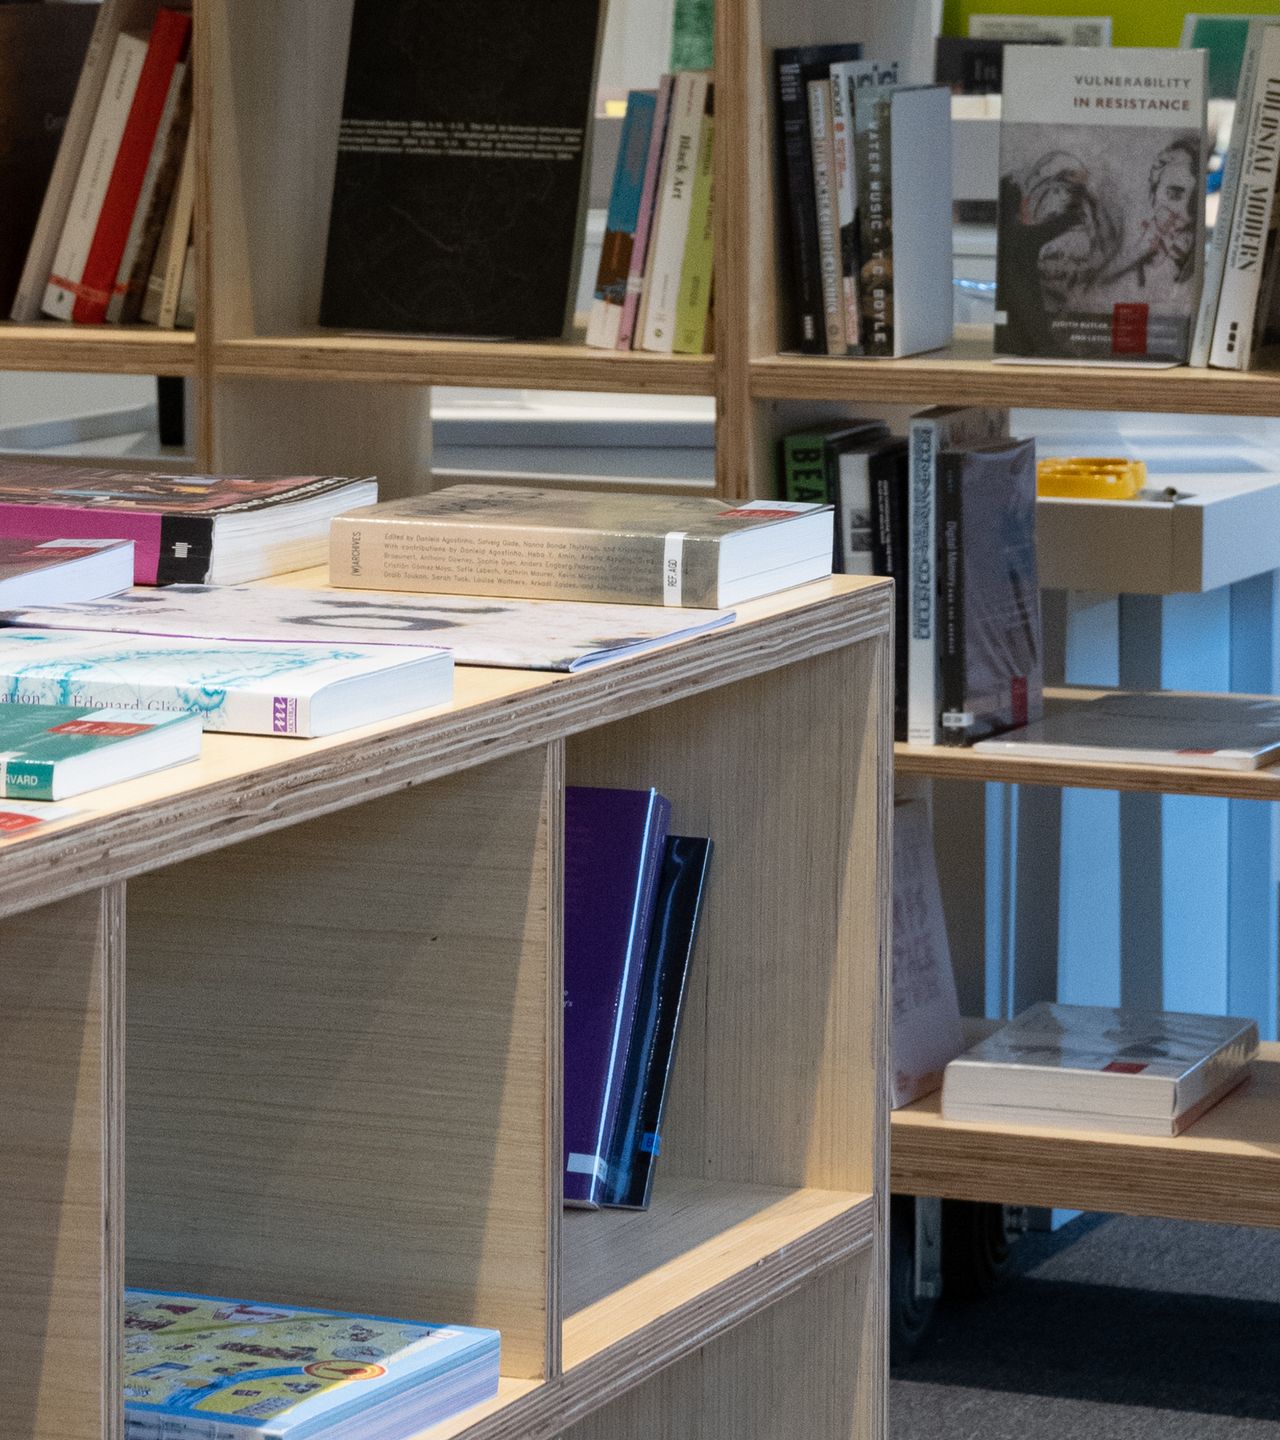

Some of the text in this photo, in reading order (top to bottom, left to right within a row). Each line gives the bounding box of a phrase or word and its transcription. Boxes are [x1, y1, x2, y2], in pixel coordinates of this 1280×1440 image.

[1073, 74, 1191, 89] VULNERABILITY
[1073, 96, 1190, 111] IN RESISTANCE
[1236, 184, 1269, 274] MODERN
[349, 530, 363, 577] (W)ARCHIVES
